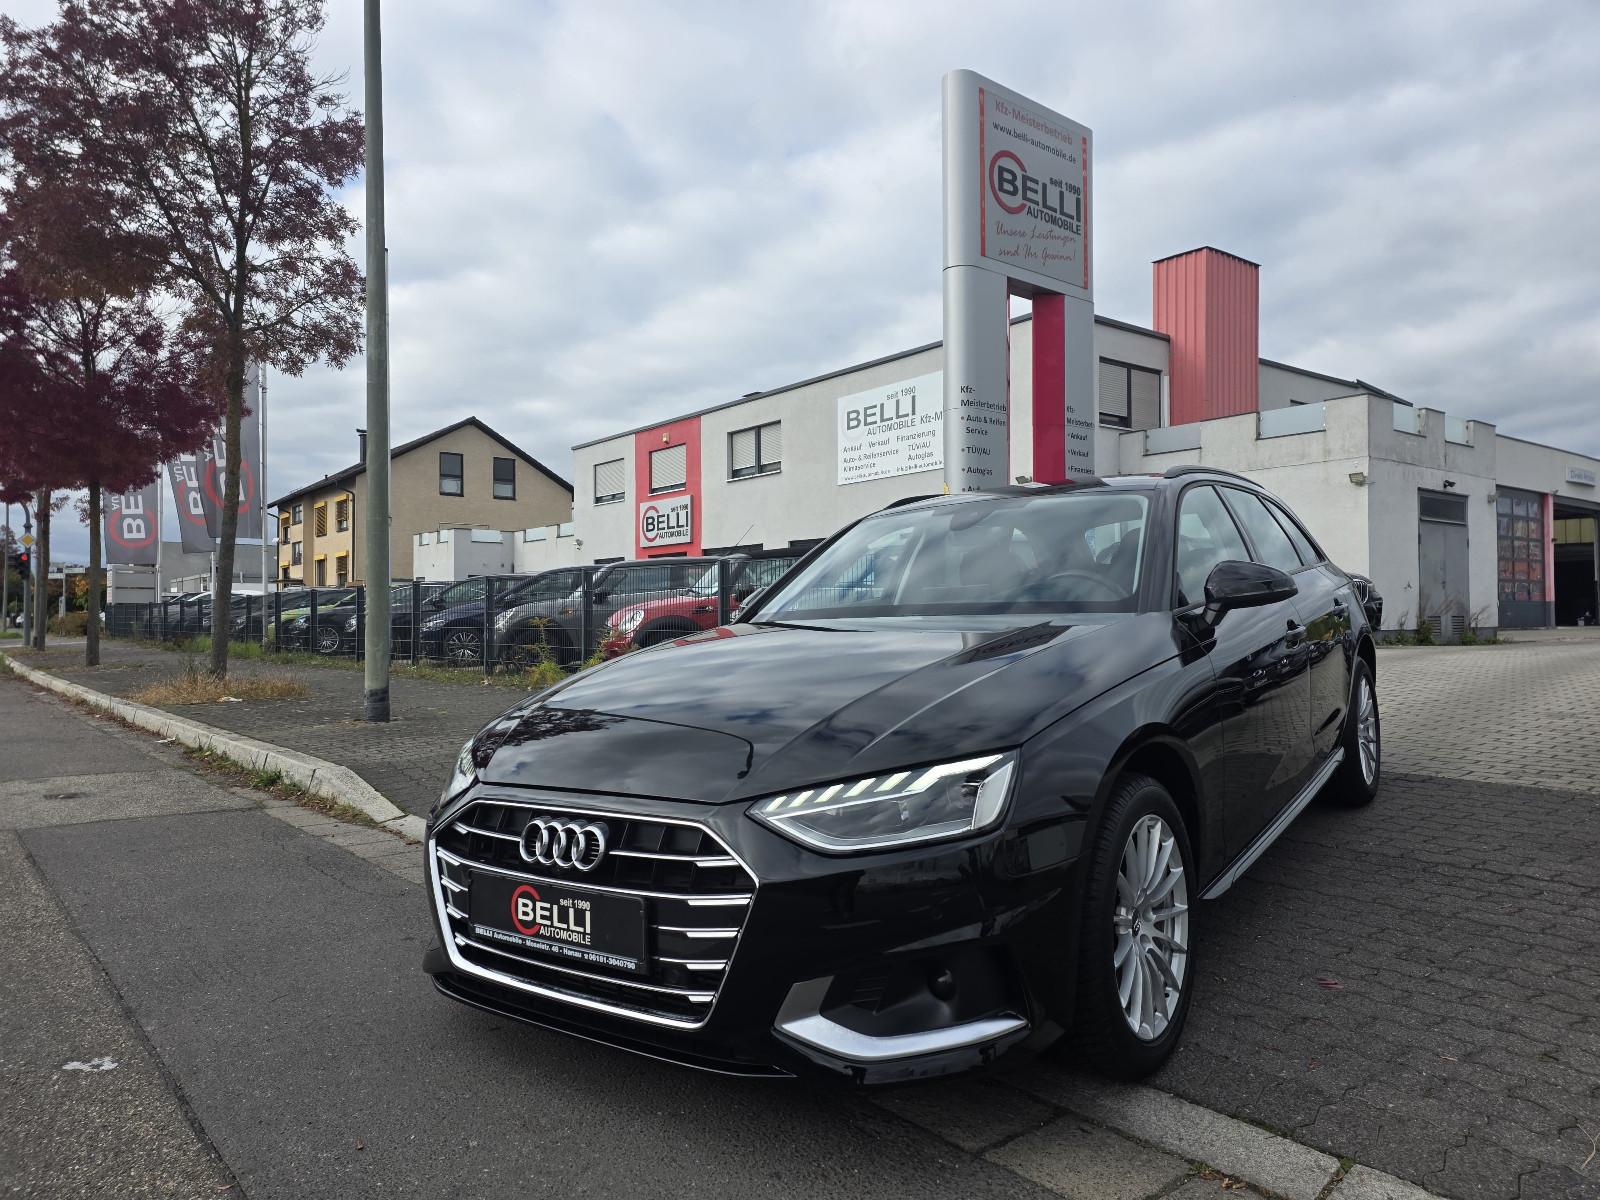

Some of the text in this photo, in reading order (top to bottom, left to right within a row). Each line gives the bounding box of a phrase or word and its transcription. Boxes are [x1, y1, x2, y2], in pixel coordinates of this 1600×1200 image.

[995, 100, 1073, 145] Kfz-Meisterbetrieb
[992, 121, 1077, 164] www.belli-automobile.de
[998, 165, 1081, 223] BELLI
[1049, 177, 1081, 196] seit 1990
[1027, 206, 1081, 236] AUTOMOBILE
[995, 221, 1077, 247] Unsere Leistungen
[886, 386, 916, 401] seit 1990
[960, 385, 976, 394] Kfz-
[846, 394, 916, 431] BELLI
[960, 399, 1007, 412] Meisterbetrieb
[867, 417, 916, 437] AUTOMOBILE
[966, 414, 982, 423] Auto
[868, 438, 890, 449] Verkauf
[896, 429, 936, 443] Finanzierung
[966, 426, 988, 436] Service
[645, 510, 689, 533] BELLI
[658, 529, 689, 539] AUTOMOBILE
[560, 898, 590, 911] seit 1990
[517, 897, 591, 934] BELLI
[475, 927, 493, 938] BELLI
[493, 931, 523, 945] Automobile
[563, 947, 582, 958] Hanau
[539, 925, 591, 945] AUTOMOBILE
